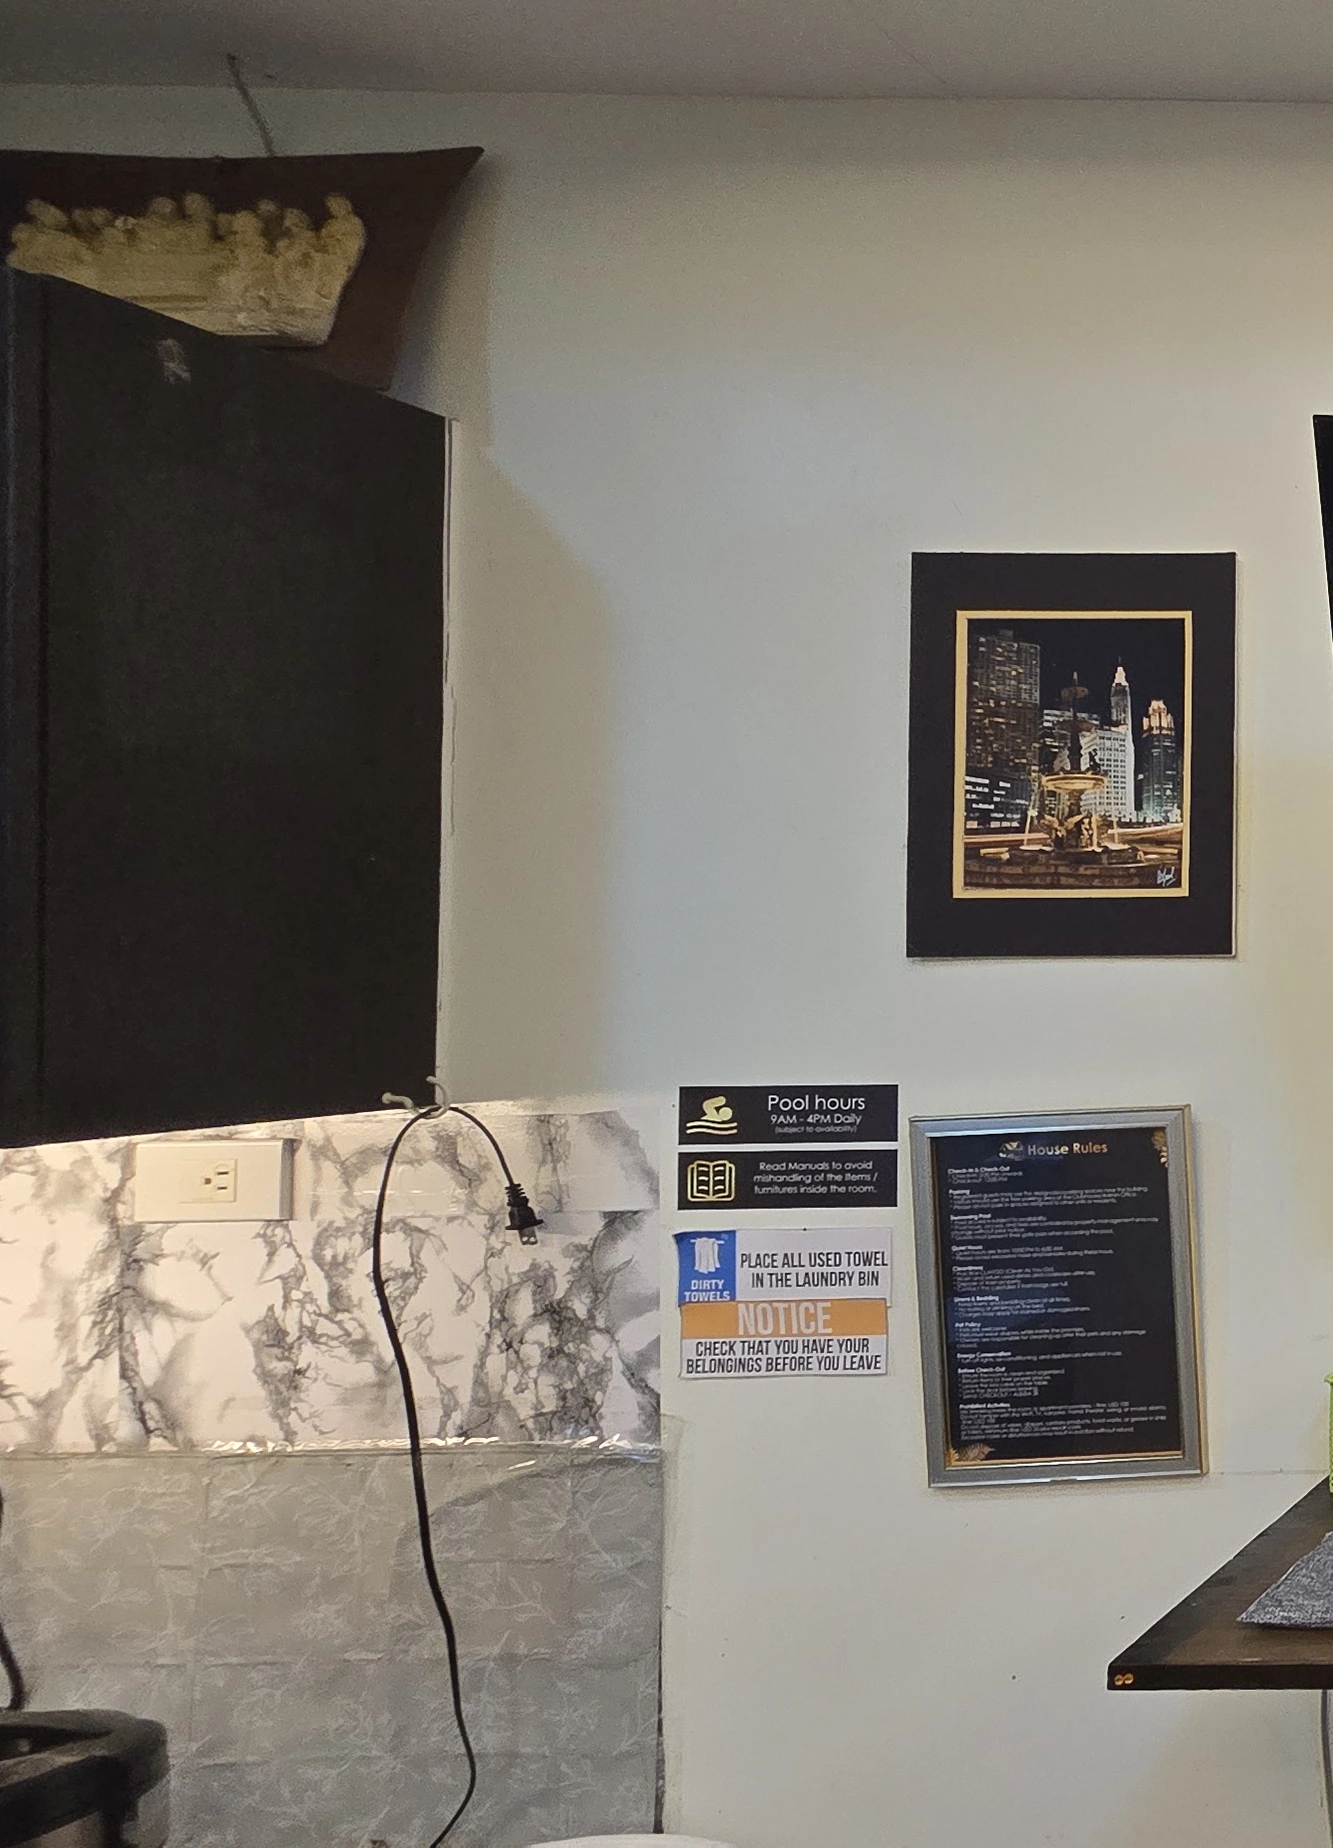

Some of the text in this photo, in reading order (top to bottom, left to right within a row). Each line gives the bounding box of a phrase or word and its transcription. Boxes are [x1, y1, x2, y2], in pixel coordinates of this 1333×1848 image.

[767, 1094, 866, 1111] Pool hours
[770, 1114, 797, 1125] 9AM
[806, 1114, 832, 1124] 4PM
[833, 1113, 862, 1126] Daily
[1028, 1142, 1108, 1156] House Rules
[759, 1161, 873, 1171] Read Manuals to avoid
[753, 1173, 812, 1184] mishandling
[814, 1173, 825, 1182] of
[826, 1173, 843, 1182] the
[754, 1184, 877, 1195] furnitures inside the room.
[740, 1251, 889, 1269] PLACE ALL USED TOWEL
[691, 1279, 725, 1291] DIRTY
[751, 1270, 880, 1288] IN THE LAUNDRY BIN
[683, 1291, 731, 1302] TOWELS
[737, 1301, 833, 1336] NOTICE
[695, 1338, 870, 1357] CHECK THAT YOU HAVE YOUR
[686, 1354, 882, 1374] BELONGINGS BEFORE YOU LEAVE
